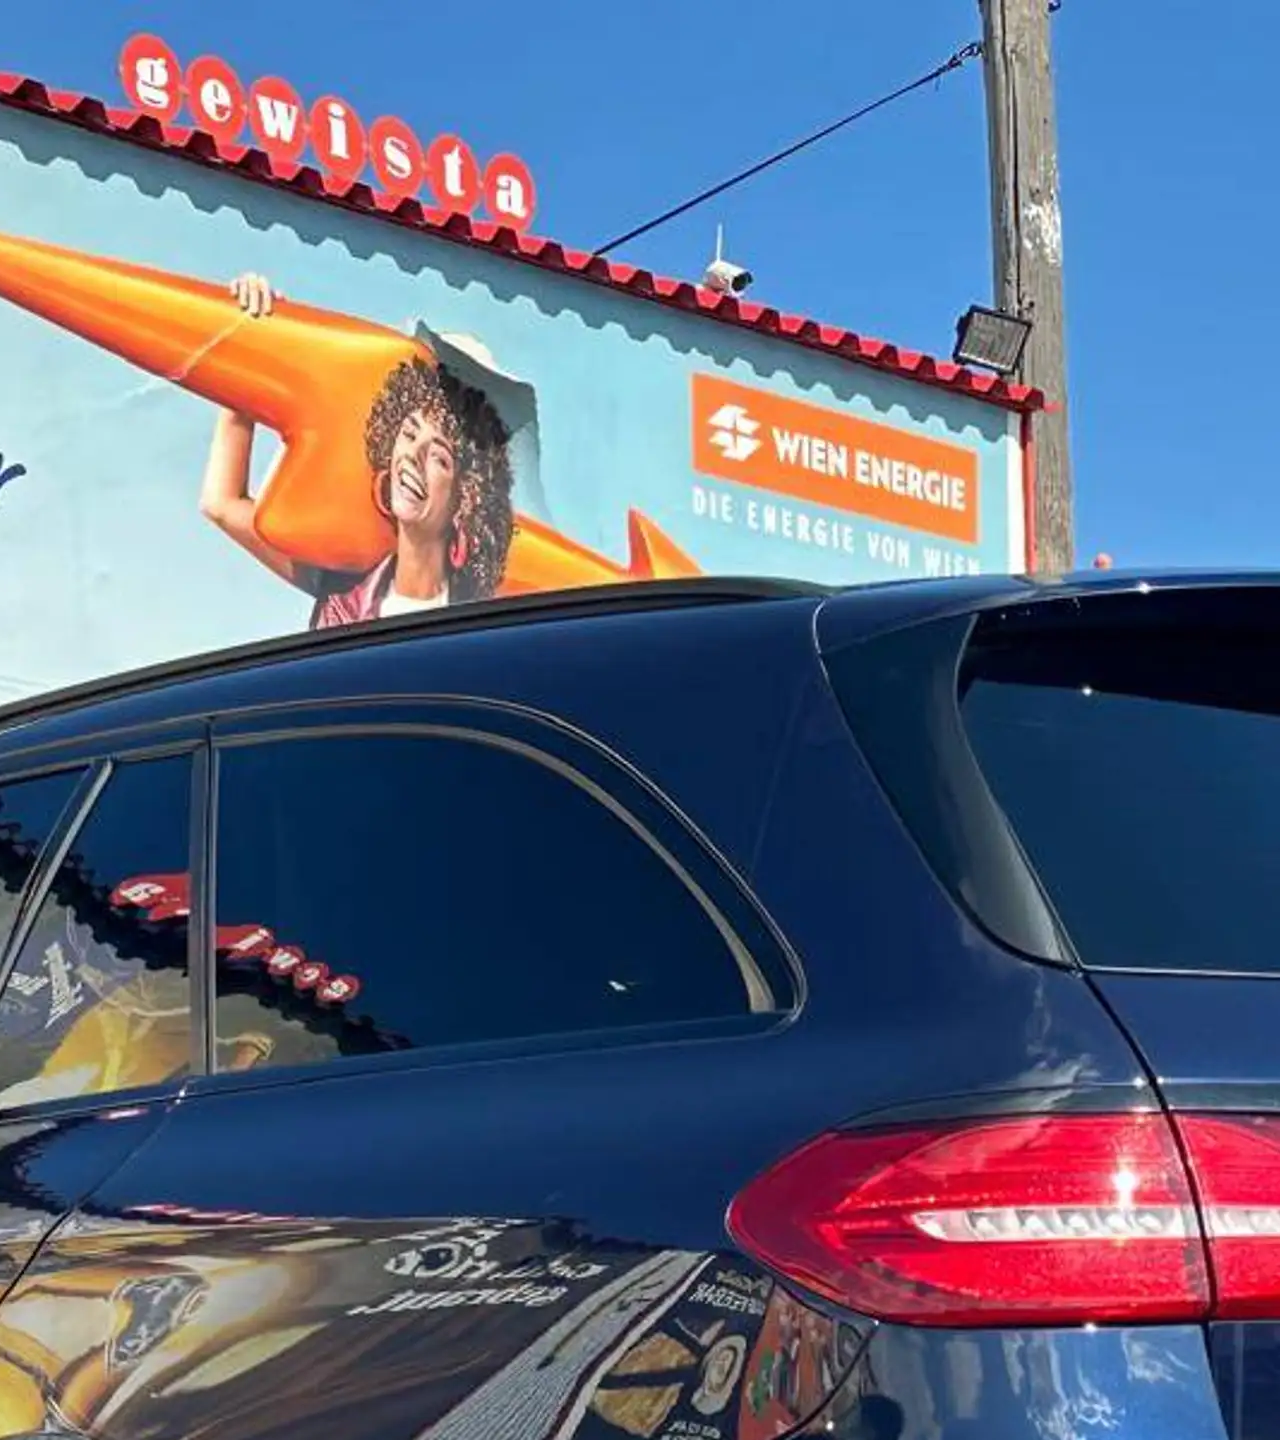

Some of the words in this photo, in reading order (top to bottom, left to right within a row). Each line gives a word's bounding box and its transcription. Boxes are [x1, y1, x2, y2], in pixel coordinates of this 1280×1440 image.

[135, 56, 527, 218] gewista
[771, 426, 848, 479] WIEN
[855, 450, 967, 512] ENERGIE
[691, 486, 733, 524] DIE
[746, 501, 856, 554] ENERGIE
[866, 531, 912, 569] VON
